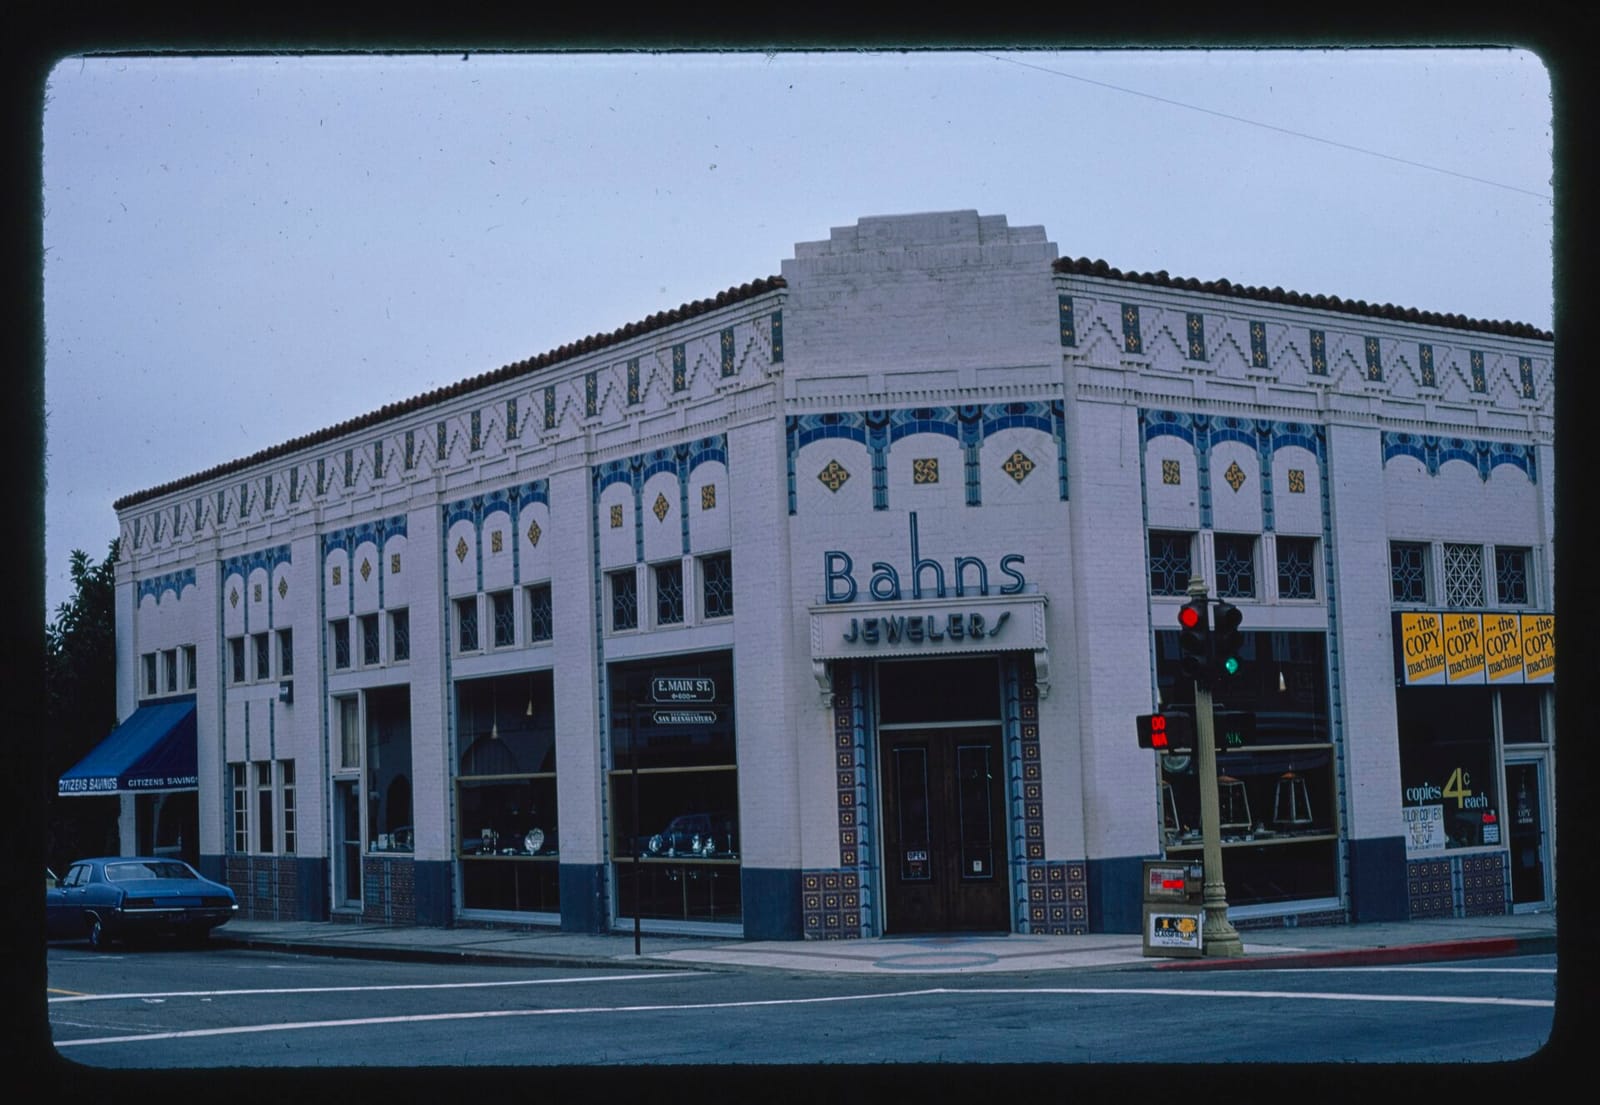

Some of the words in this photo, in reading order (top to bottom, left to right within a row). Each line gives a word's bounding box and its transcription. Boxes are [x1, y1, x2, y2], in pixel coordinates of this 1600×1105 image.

[824, 511, 1025, 604] Bahns
[843, 611, 1011, 644] JEWELERS
[1405, 628, 1440, 657] COPY
[1446, 629, 1480, 657] COPY
[1486, 629, 1519, 657] COPY
[1524, 631, 1555, 657] COPY
[1407, 653, 1445, 675] machine
[1449, 653, 1485, 676] machine
[1487, 653, 1522, 675] machine
[1526, 654, 1555, 675] machin
[696, 680, 711, 692] ST.
[59, 779, 88, 791] CITIZENS
[89, 777, 118, 790] SAVINGS
[128, 779, 164, 787] CITIZENS
[1406, 782, 1442, 806] copies
[1464, 792, 1488, 808] each
[1408, 821, 1435, 834] HERE
